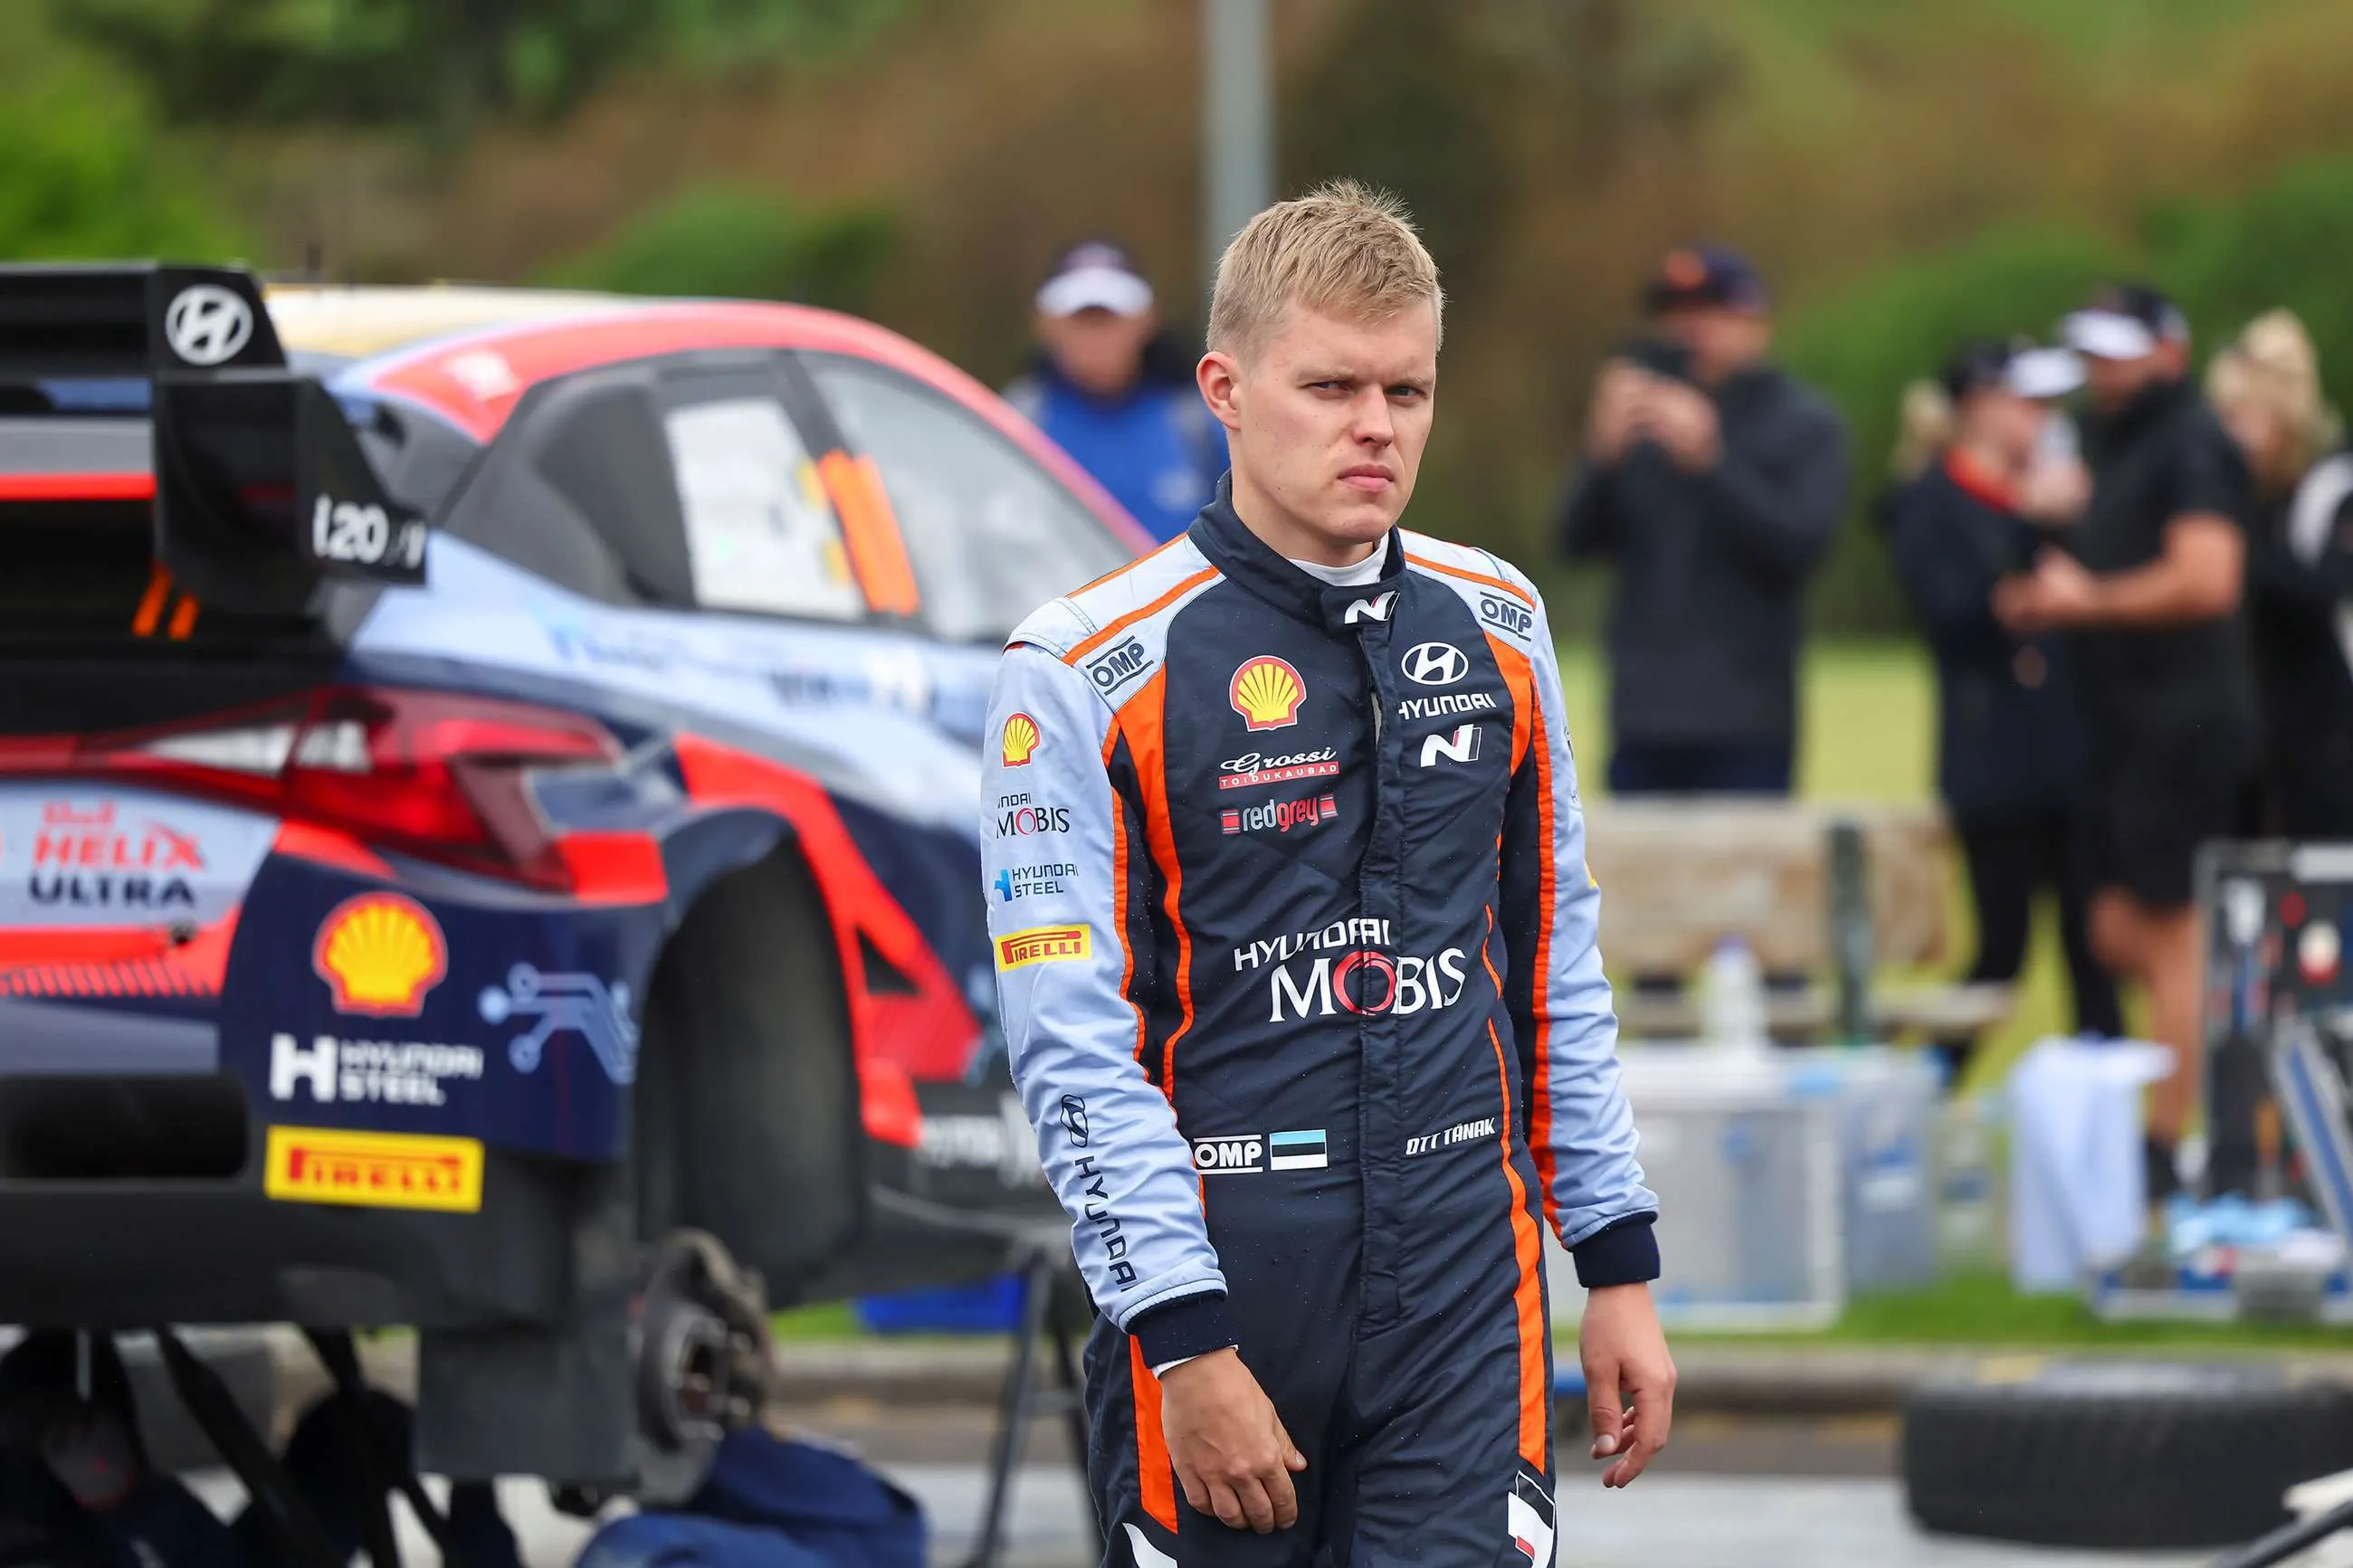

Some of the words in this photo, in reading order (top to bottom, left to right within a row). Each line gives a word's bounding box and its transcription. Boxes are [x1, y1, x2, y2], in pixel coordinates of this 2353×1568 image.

[1481, 598, 1533, 633] OMP
[1091, 641, 1145, 688] OMP
[1398, 693, 1497, 720] HYUNDAI
[1220, 746, 1337, 776] Grossi
[1221, 765, 1338, 787] TOIDUKAUBAD
[996, 807, 1071, 840] MOBIS
[1243, 797, 1319, 832] redgrey
[33, 823, 206, 871] HELIX
[1012, 863, 1080, 881] HYUNDAI
[28, 874, 197, 908] ULTRA
[1015, 881, 1064, 898] STEEL
[1001, 930, 1082, 965] PIRELLI
[1269, 947, 1466, 1022] MOBIS
[1195, 1141, 1263, 1168] OMP
[1405, 1132, 1442, 1155] OTT
[287, 1147, 462, 1195] PIRELLI
